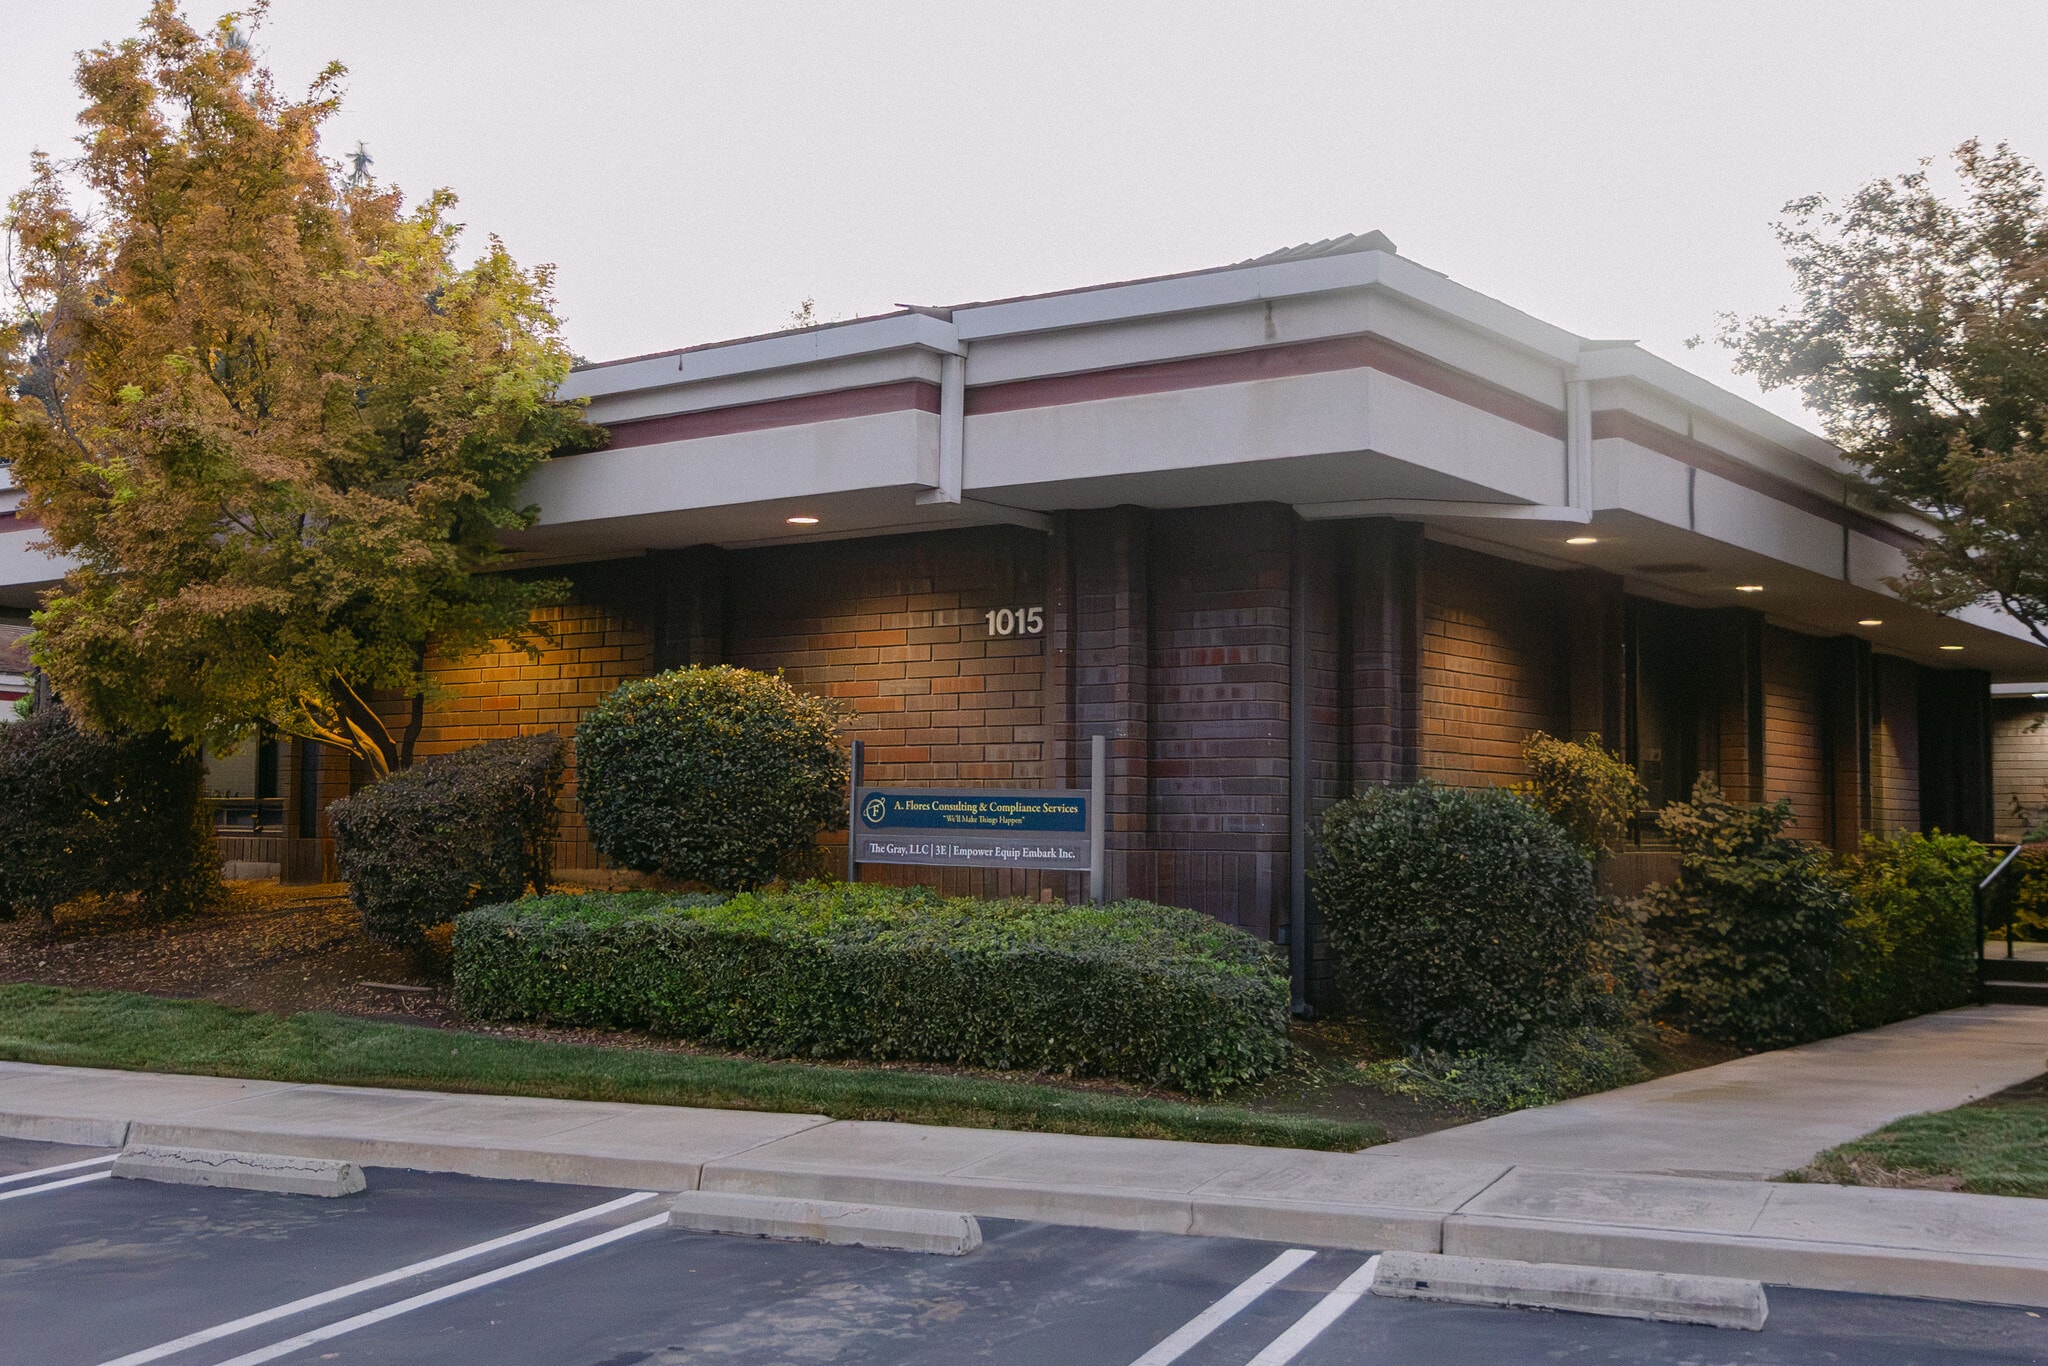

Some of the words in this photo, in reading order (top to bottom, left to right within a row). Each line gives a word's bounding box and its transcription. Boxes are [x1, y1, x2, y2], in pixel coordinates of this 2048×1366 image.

[985, 607, 1043, 636] 1015
[894, 800, 905, 810] A.
[905, 800, 930, 811] Flores
[931, 801, 978, 815] Consulting
[979, 802, 987, 812] &
[989, 802, 1041, 816] Compliance
[1042, 803, 1079, 814] Services
[961, 815, 978, 824] Make
[979, 815, 998, 826] Things
[869, 843, 885, 853] The
[886, 843, 908, 857] Gray,
[909, 844, 929, 855] LLC
[935, 845, 947, 855] 3E
[953, 845, 994, 859] Empower
[994, 846, 1021, 861] Equip
[1022, 847, 1057, 859] Embark
[1058, 848, 1076, 859] Inc.
